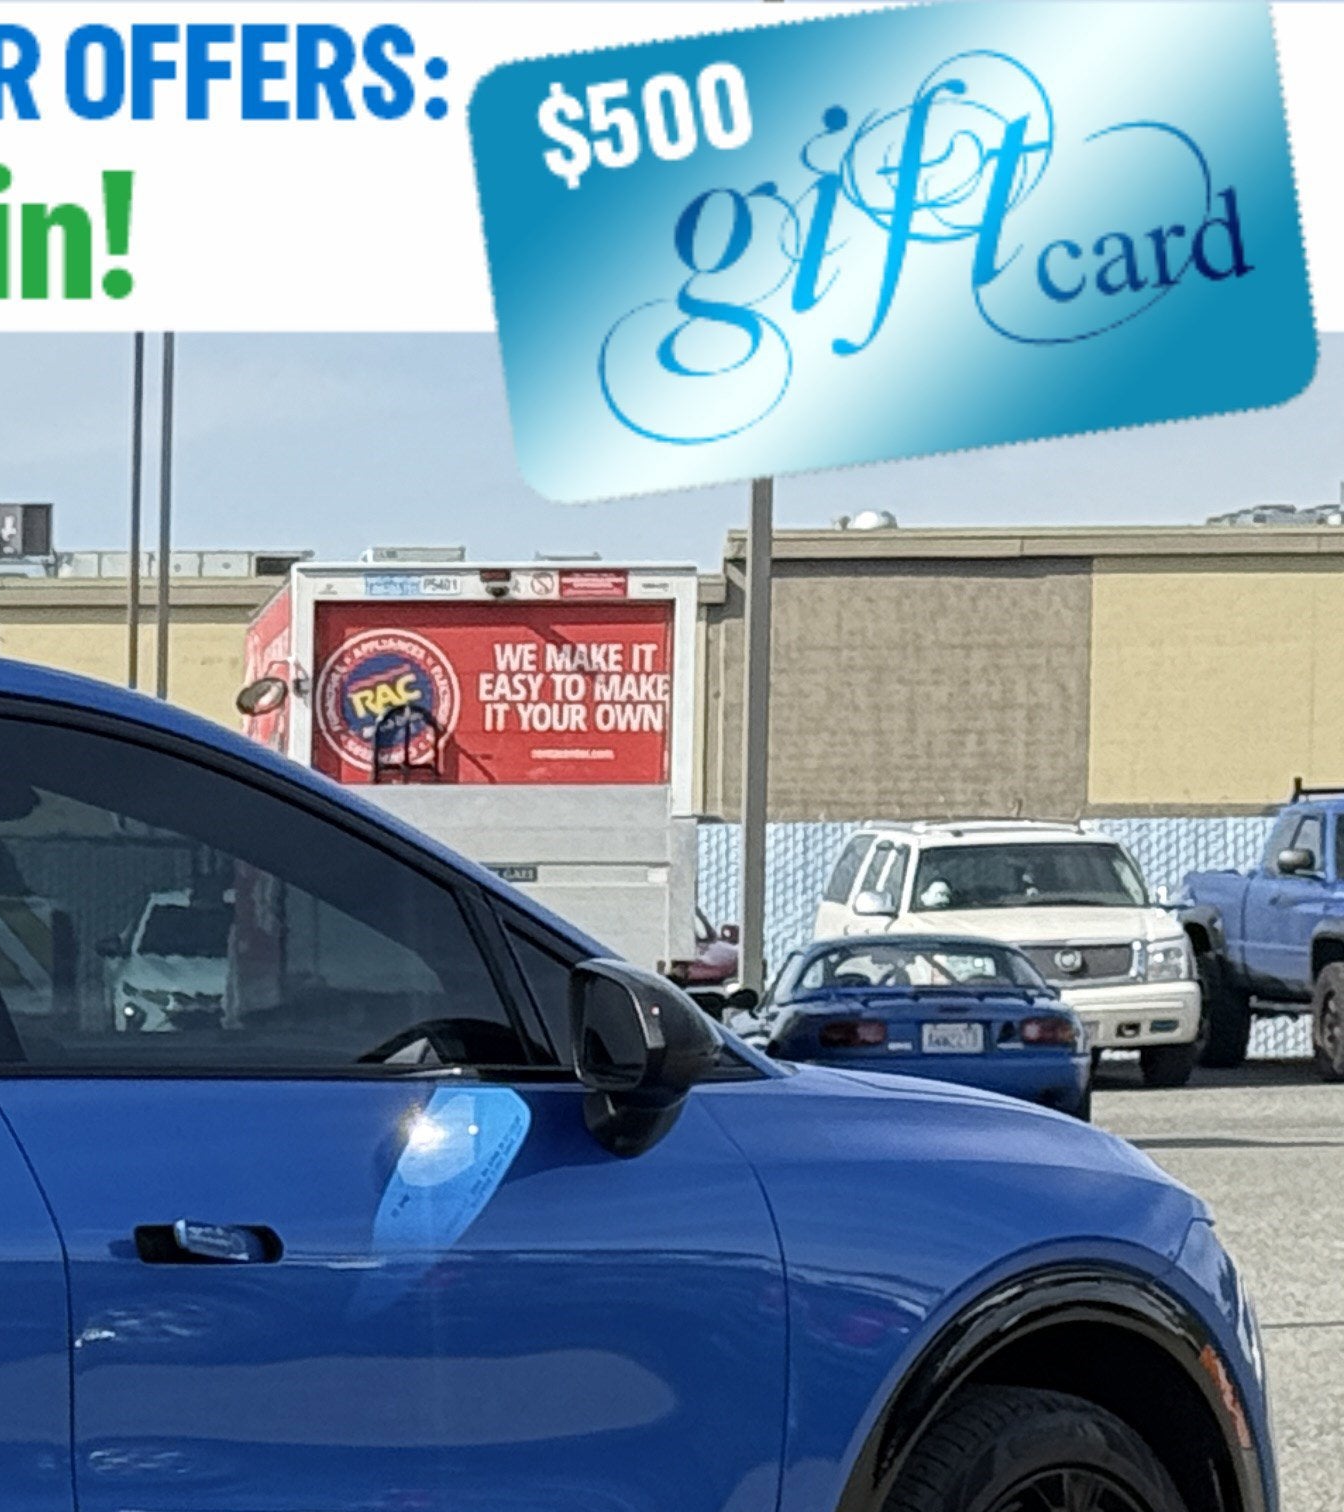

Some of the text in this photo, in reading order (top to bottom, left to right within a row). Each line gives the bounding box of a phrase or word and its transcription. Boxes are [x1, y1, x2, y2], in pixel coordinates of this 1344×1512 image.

[494, 643, 658, 672] WE MAKE IT
[348, 673, 422, 719] RAC
[479, 673, 544, 701] EASY
[551, 673, 586, 701] TO
[593, 674, 670, 701] MAKE
[484, 703, 663, 732] IT YOUR OWN
